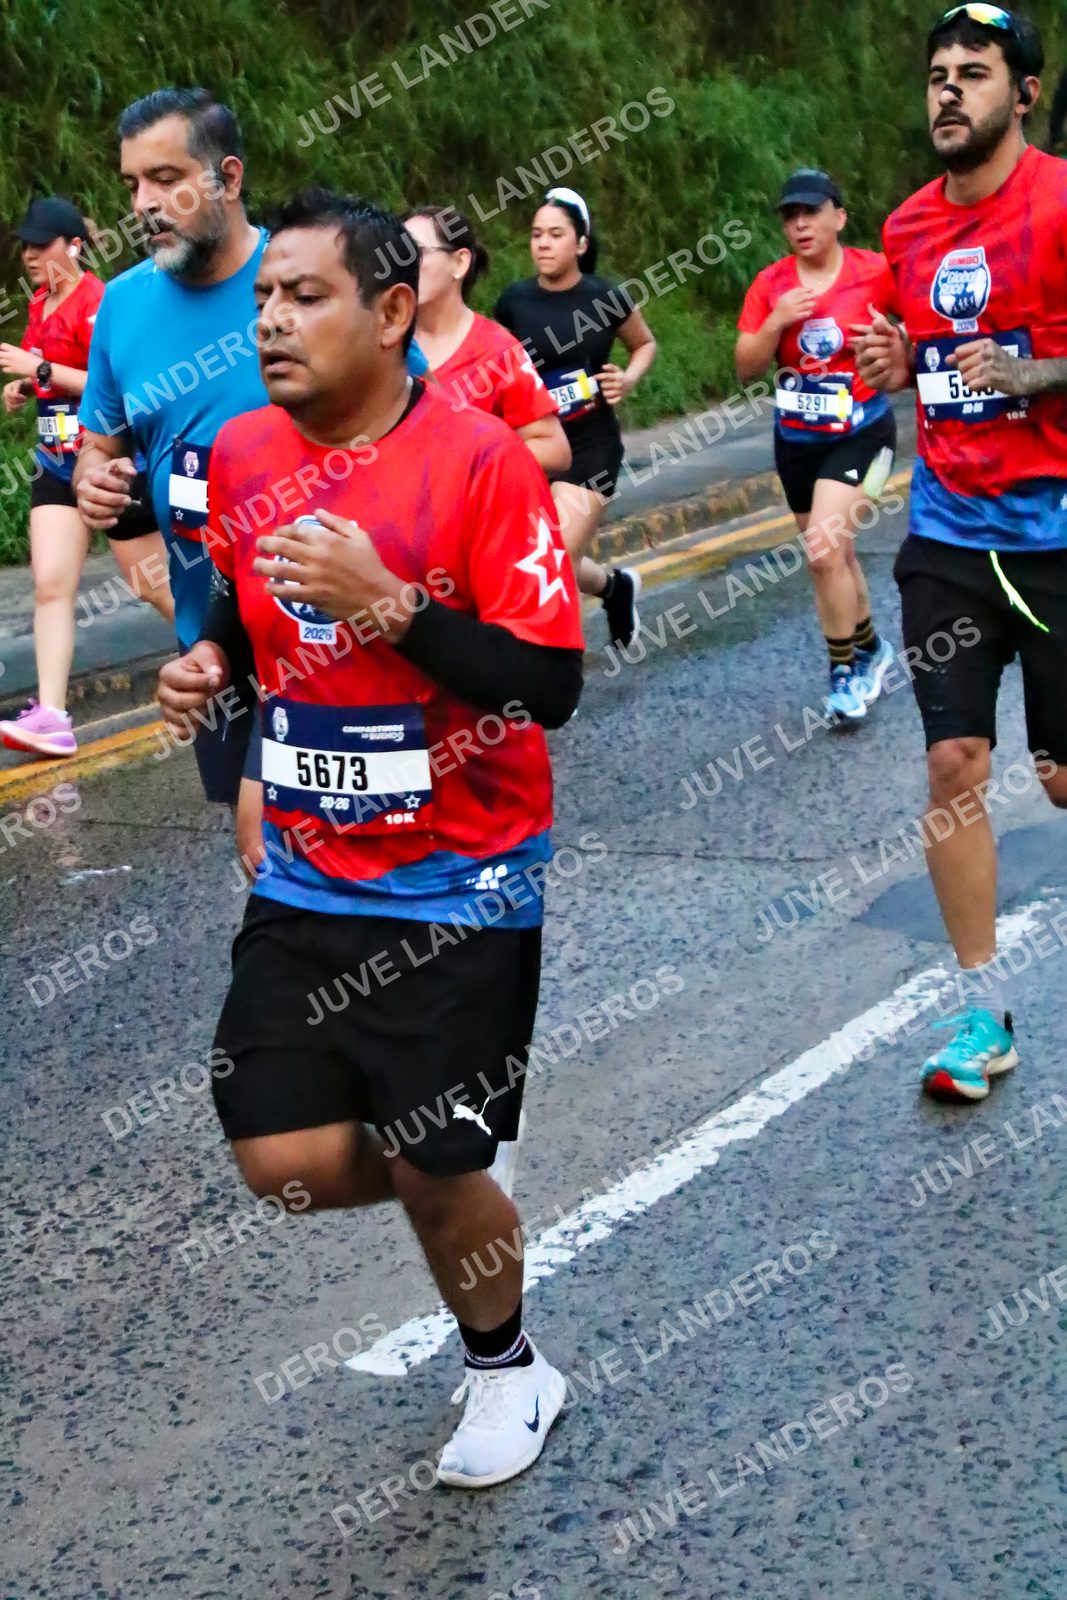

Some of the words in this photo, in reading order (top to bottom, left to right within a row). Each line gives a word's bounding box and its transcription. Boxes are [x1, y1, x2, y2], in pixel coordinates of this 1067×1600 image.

[797, 395, 828, 411] 5291
[296, 751, 368, 791] 5673
[384, 812, 415, 825] 10K
